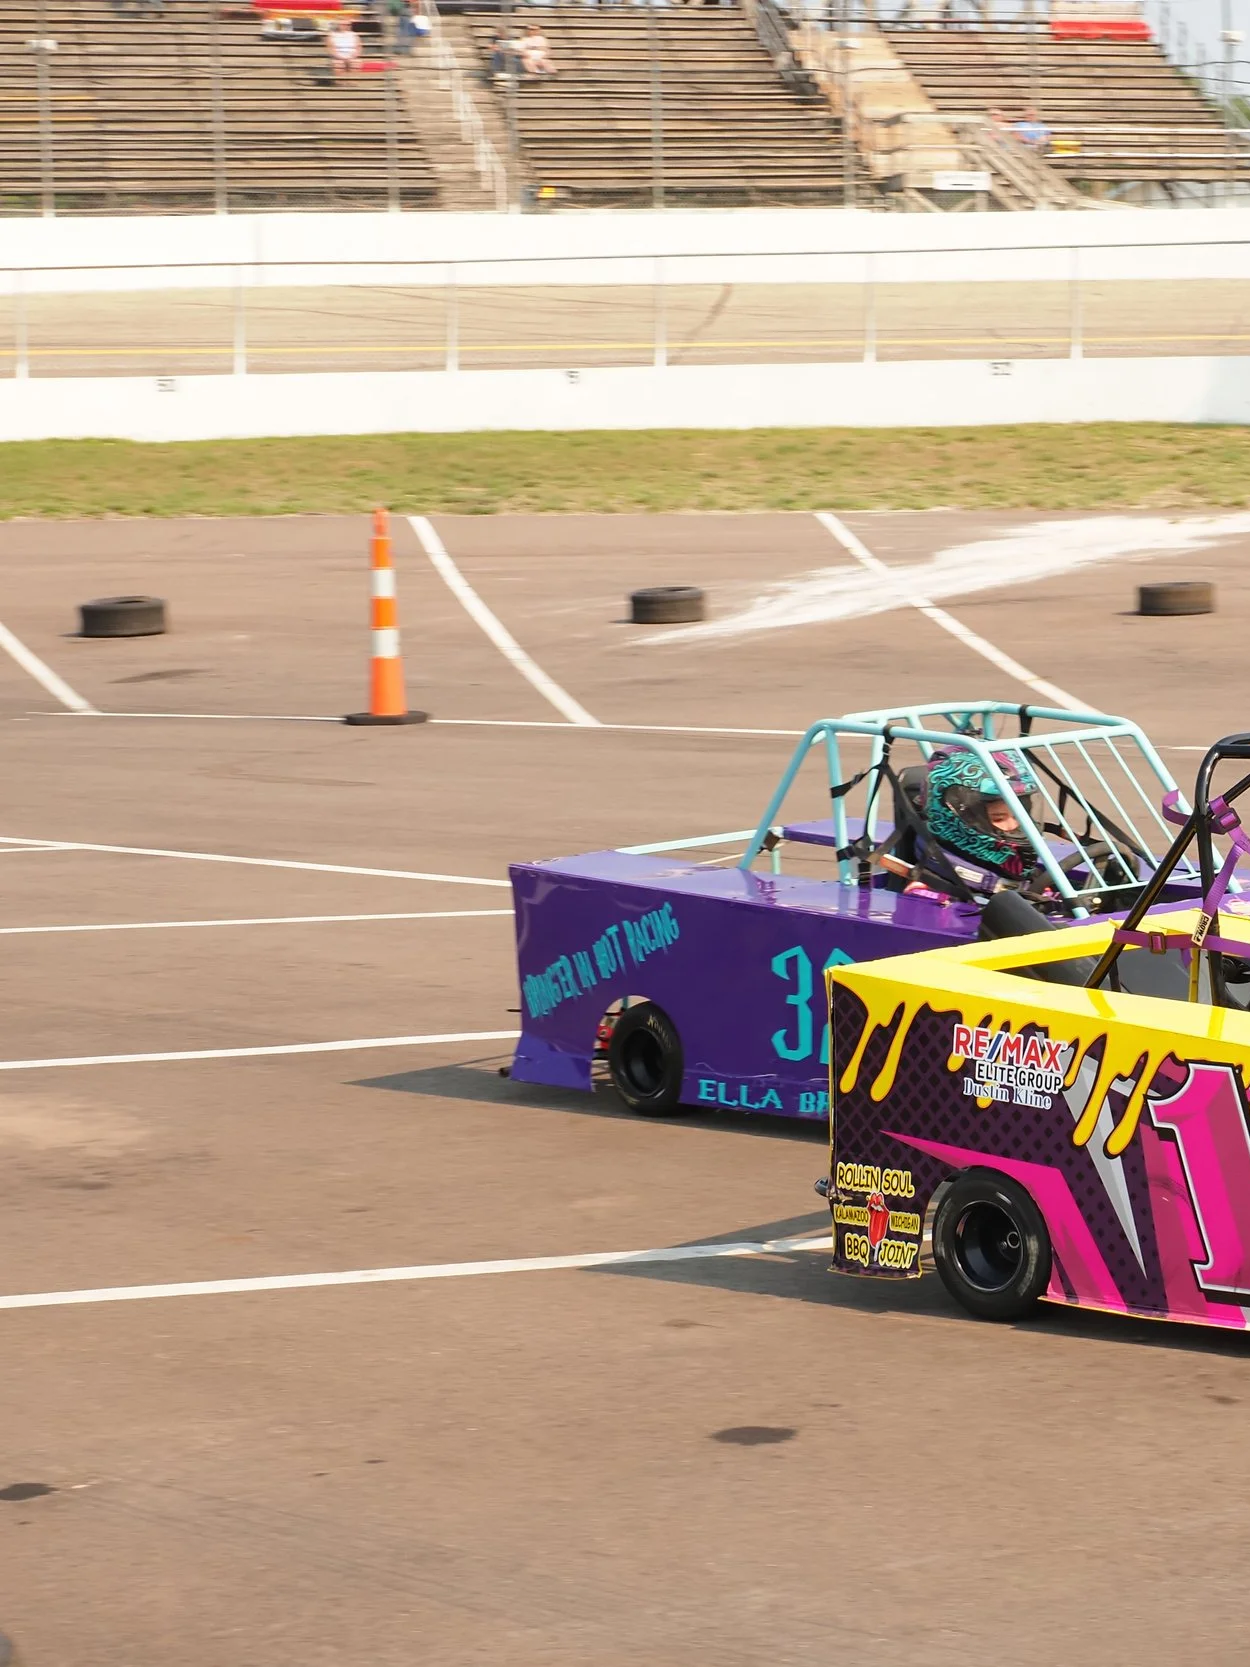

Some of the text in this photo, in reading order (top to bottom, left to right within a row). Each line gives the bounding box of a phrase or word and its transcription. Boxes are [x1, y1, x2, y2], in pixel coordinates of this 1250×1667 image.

[622, 902, 680, 965] RACING
[954, 1026, 1062, 1072] RE/MAX
[977, 1063, 1062, 1092] ELITE GROUP
[698, 1079, 783, 1109] ELLA
[964, 1079, 1051, 1109] Dustin Kline
[837, 1165, 914, 1195] ROLLIN SOUL
[846, 1236, 916, 1266] BBQ JOINT
